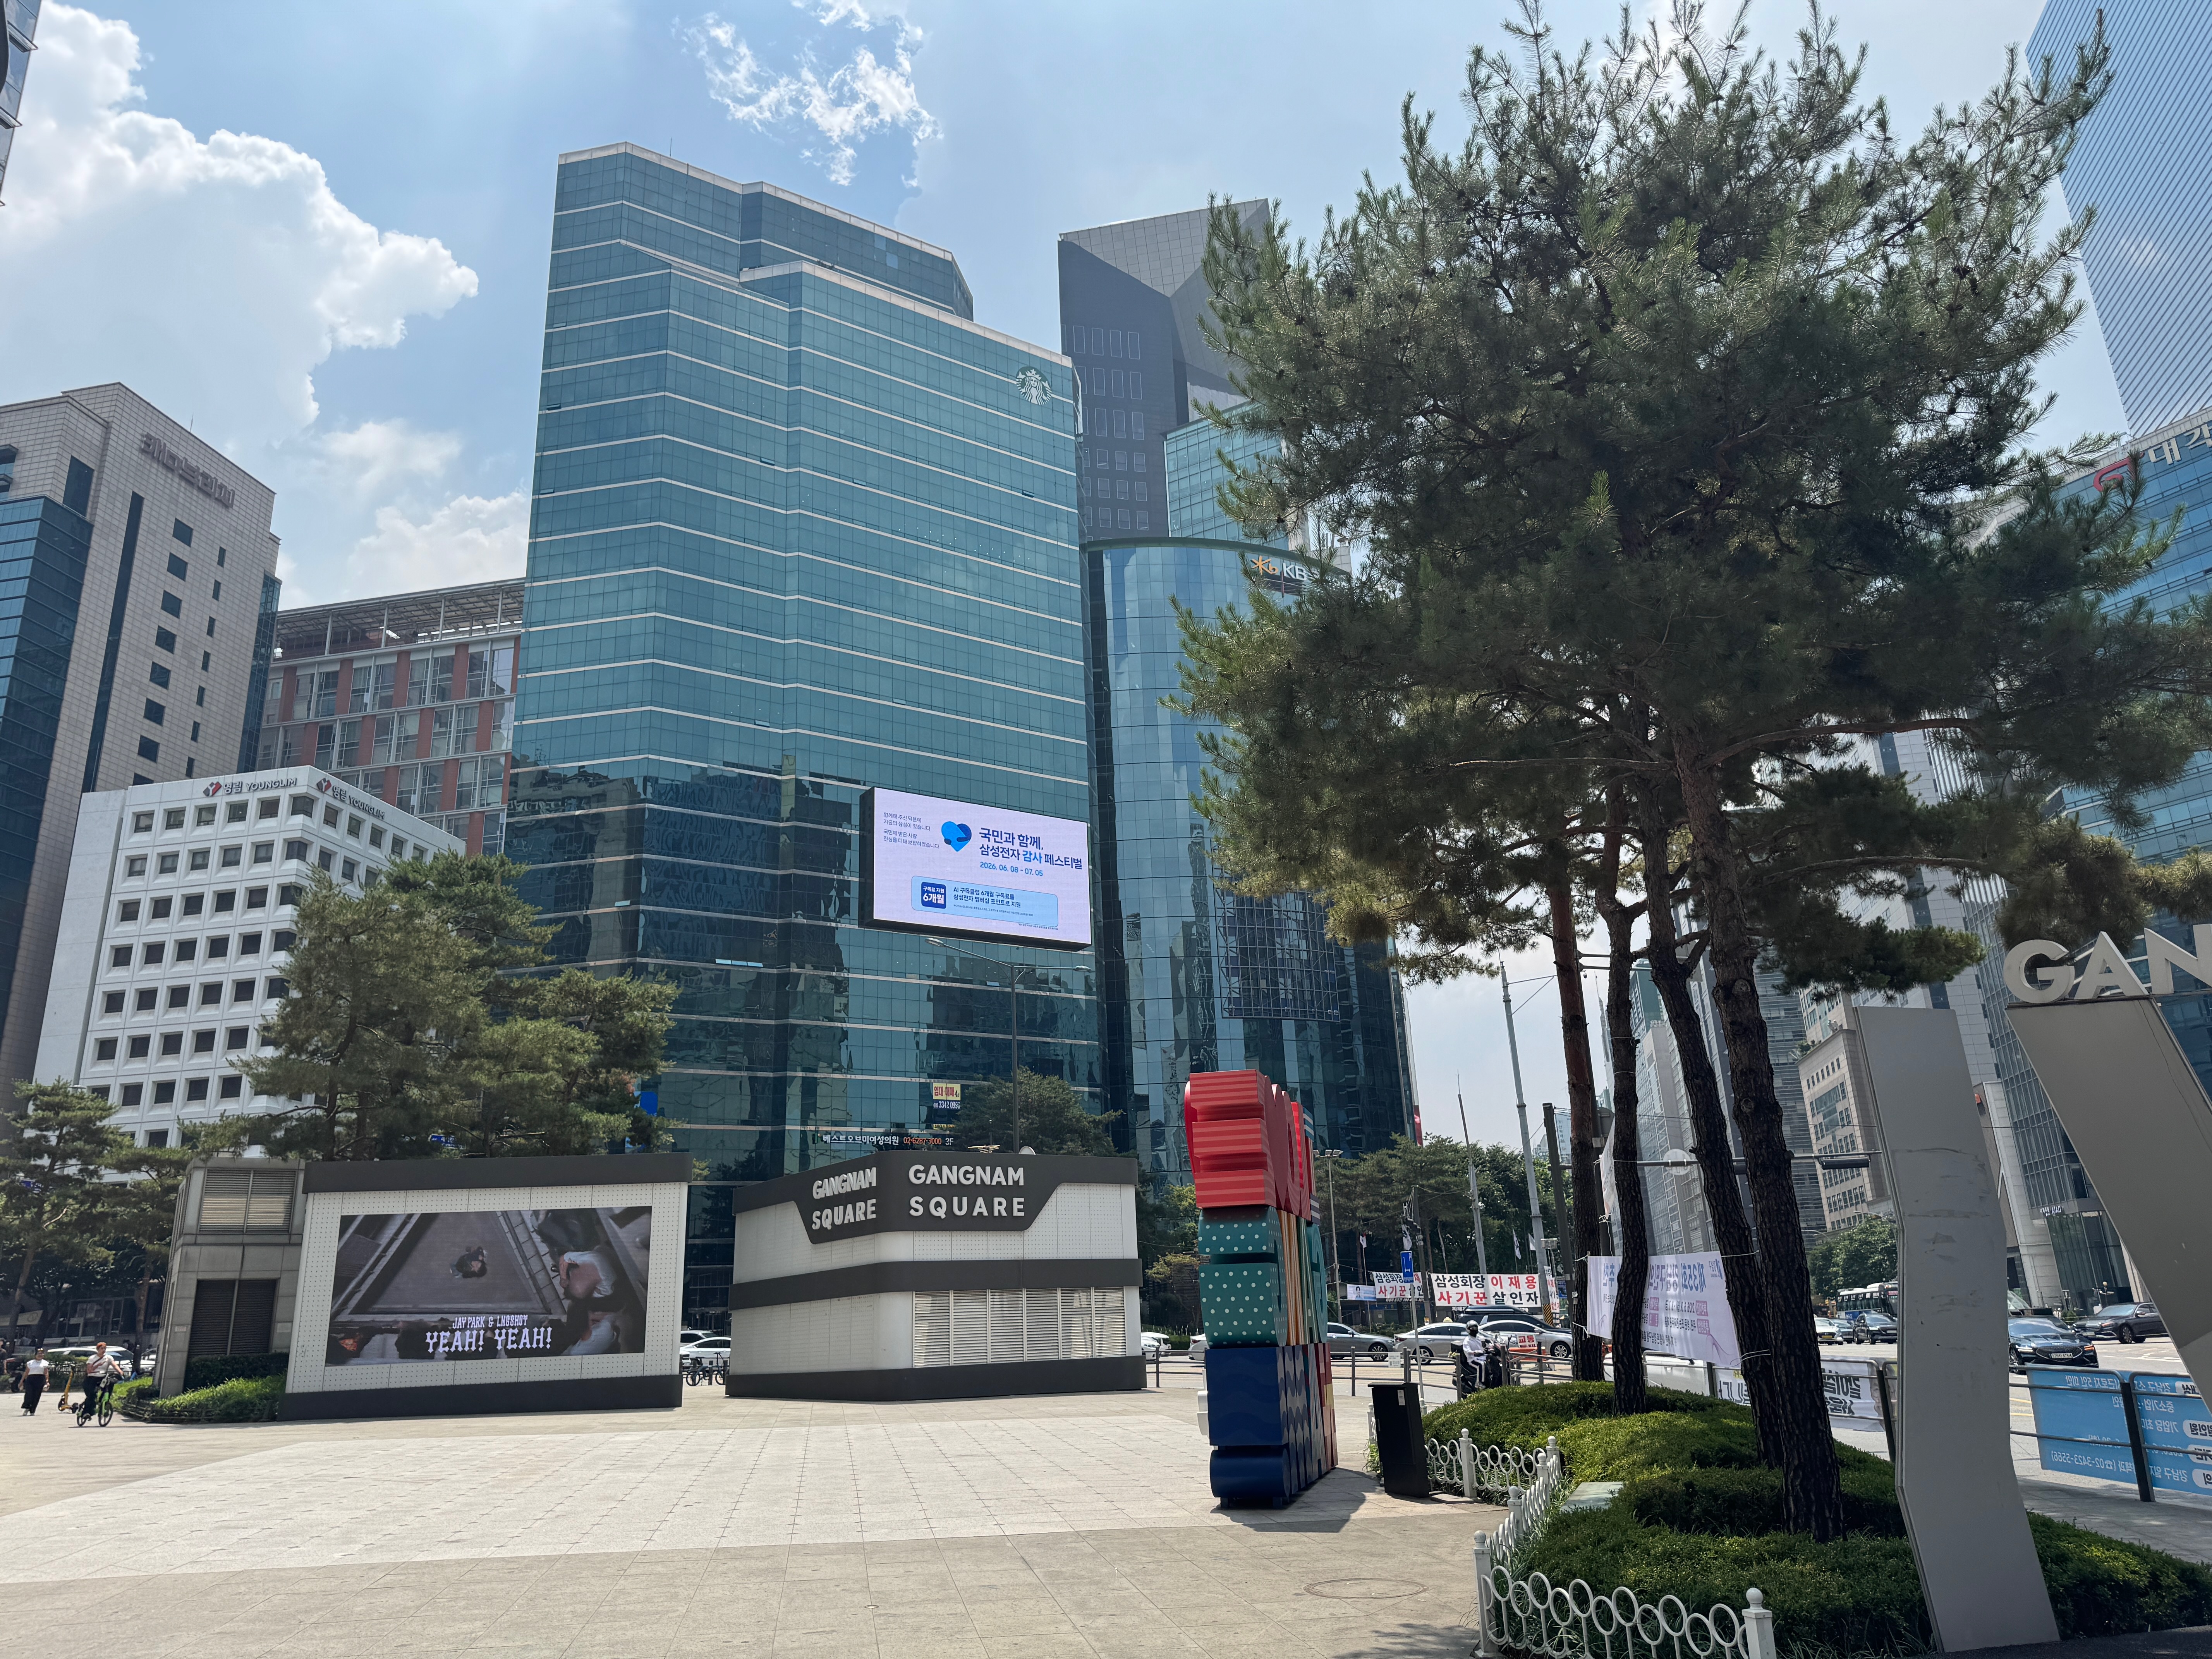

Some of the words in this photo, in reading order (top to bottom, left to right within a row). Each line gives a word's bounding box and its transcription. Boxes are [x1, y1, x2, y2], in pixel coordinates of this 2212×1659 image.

[223, 781, 242, 794] 영림
[246, 777, 297, 792] YOUNGLIM
[333, 785, 348, 802] 영림
[349, 795, 386, 820] YOUNGLIM
[908, 840, 939, 848] 보답하겠습니다
[979, 828, 1015, 846] 국민과
[1017, 833, 1043, 850] 함께,
[979, 844, 1020, 860] 삼성전자
[1022, 850, 1042, 864] 감사
[1044, 854, 1082, 869] 페스티벌
[980, 862, 997, 870] 2026.
[999, 864, 1008, 872] 06.
[923, 893, 944, 904] 6개월
[823, 1135, 899, 1145] 베스트오브미여성의원
[812, 1167, 876, 1199] GANGNAM
[908, 1164, 1024, 1186] GANGNAM
[812, 1199, 876, 1230] SQUARE
[909, 1196, 1025, 1219] SQUARE
[1376, 1273, 1404, 1283] 삼성회장
[1435, 1275, 1486, 1289] 삼성회장
[452, 1317, 466, 1329] JAY
[467, 1316, 485, 1328] PARK
[488, 1316, 494, 1327] &
[425, 1329, 485, 1353] YEAH!
[494, 1326, 552, 1350] YEAH!
[1518, 1335, 1535, 1344] 교통
